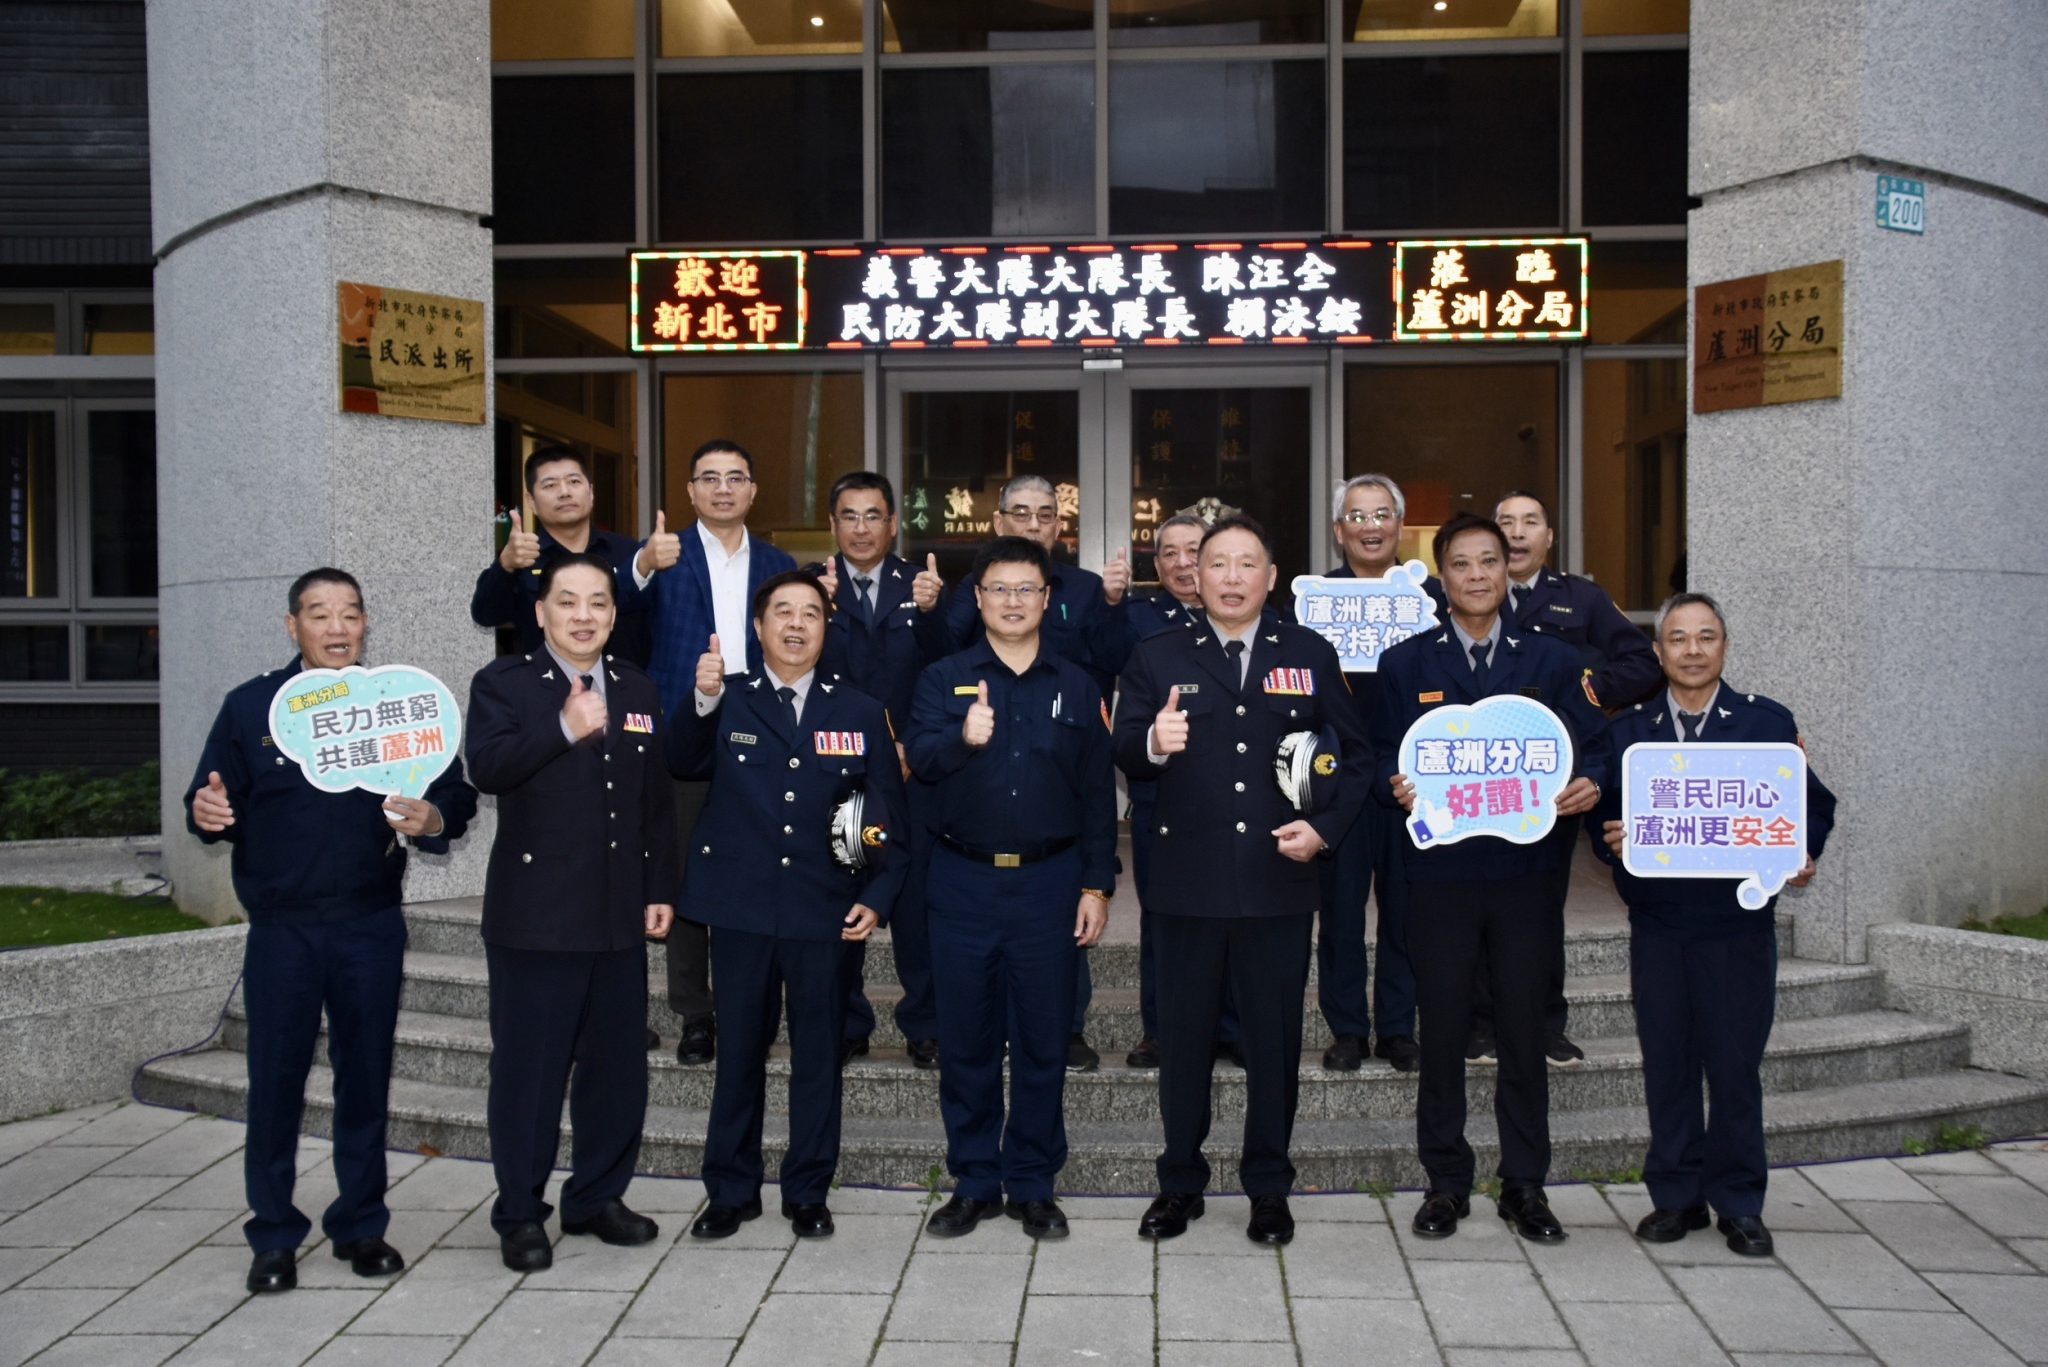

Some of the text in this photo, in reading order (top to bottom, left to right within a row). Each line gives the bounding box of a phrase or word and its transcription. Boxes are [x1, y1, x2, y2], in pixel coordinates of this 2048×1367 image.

[1892, 197, 1921, 226] 200
[674, 257, 761, 298] 歡迎
[862, 253, 1175, 299] 義警大隊大隊長
[652, 300, 782, 343] 新北市
[841, 298, 1199, 342] 民防大隊副大隊長
[1407, 289, 1573, 330] 蘆洲分局
[1706, 315, 1825, 361] 蘆洲分局
[1305, 594, 1422, 625] 蘆洲義警
[287, 681, 350, 713] 蘆洲分局
[311, 693, 439, 740] 民力無窮
[316, 726, 444, 774] 共護蘆洲
[1415, 738, 1559, 775] 蘆洲分局
[1650, 778, 1780, 809] 警民同心
[1633, 815, 1796, 847] 蘆洲更安全
